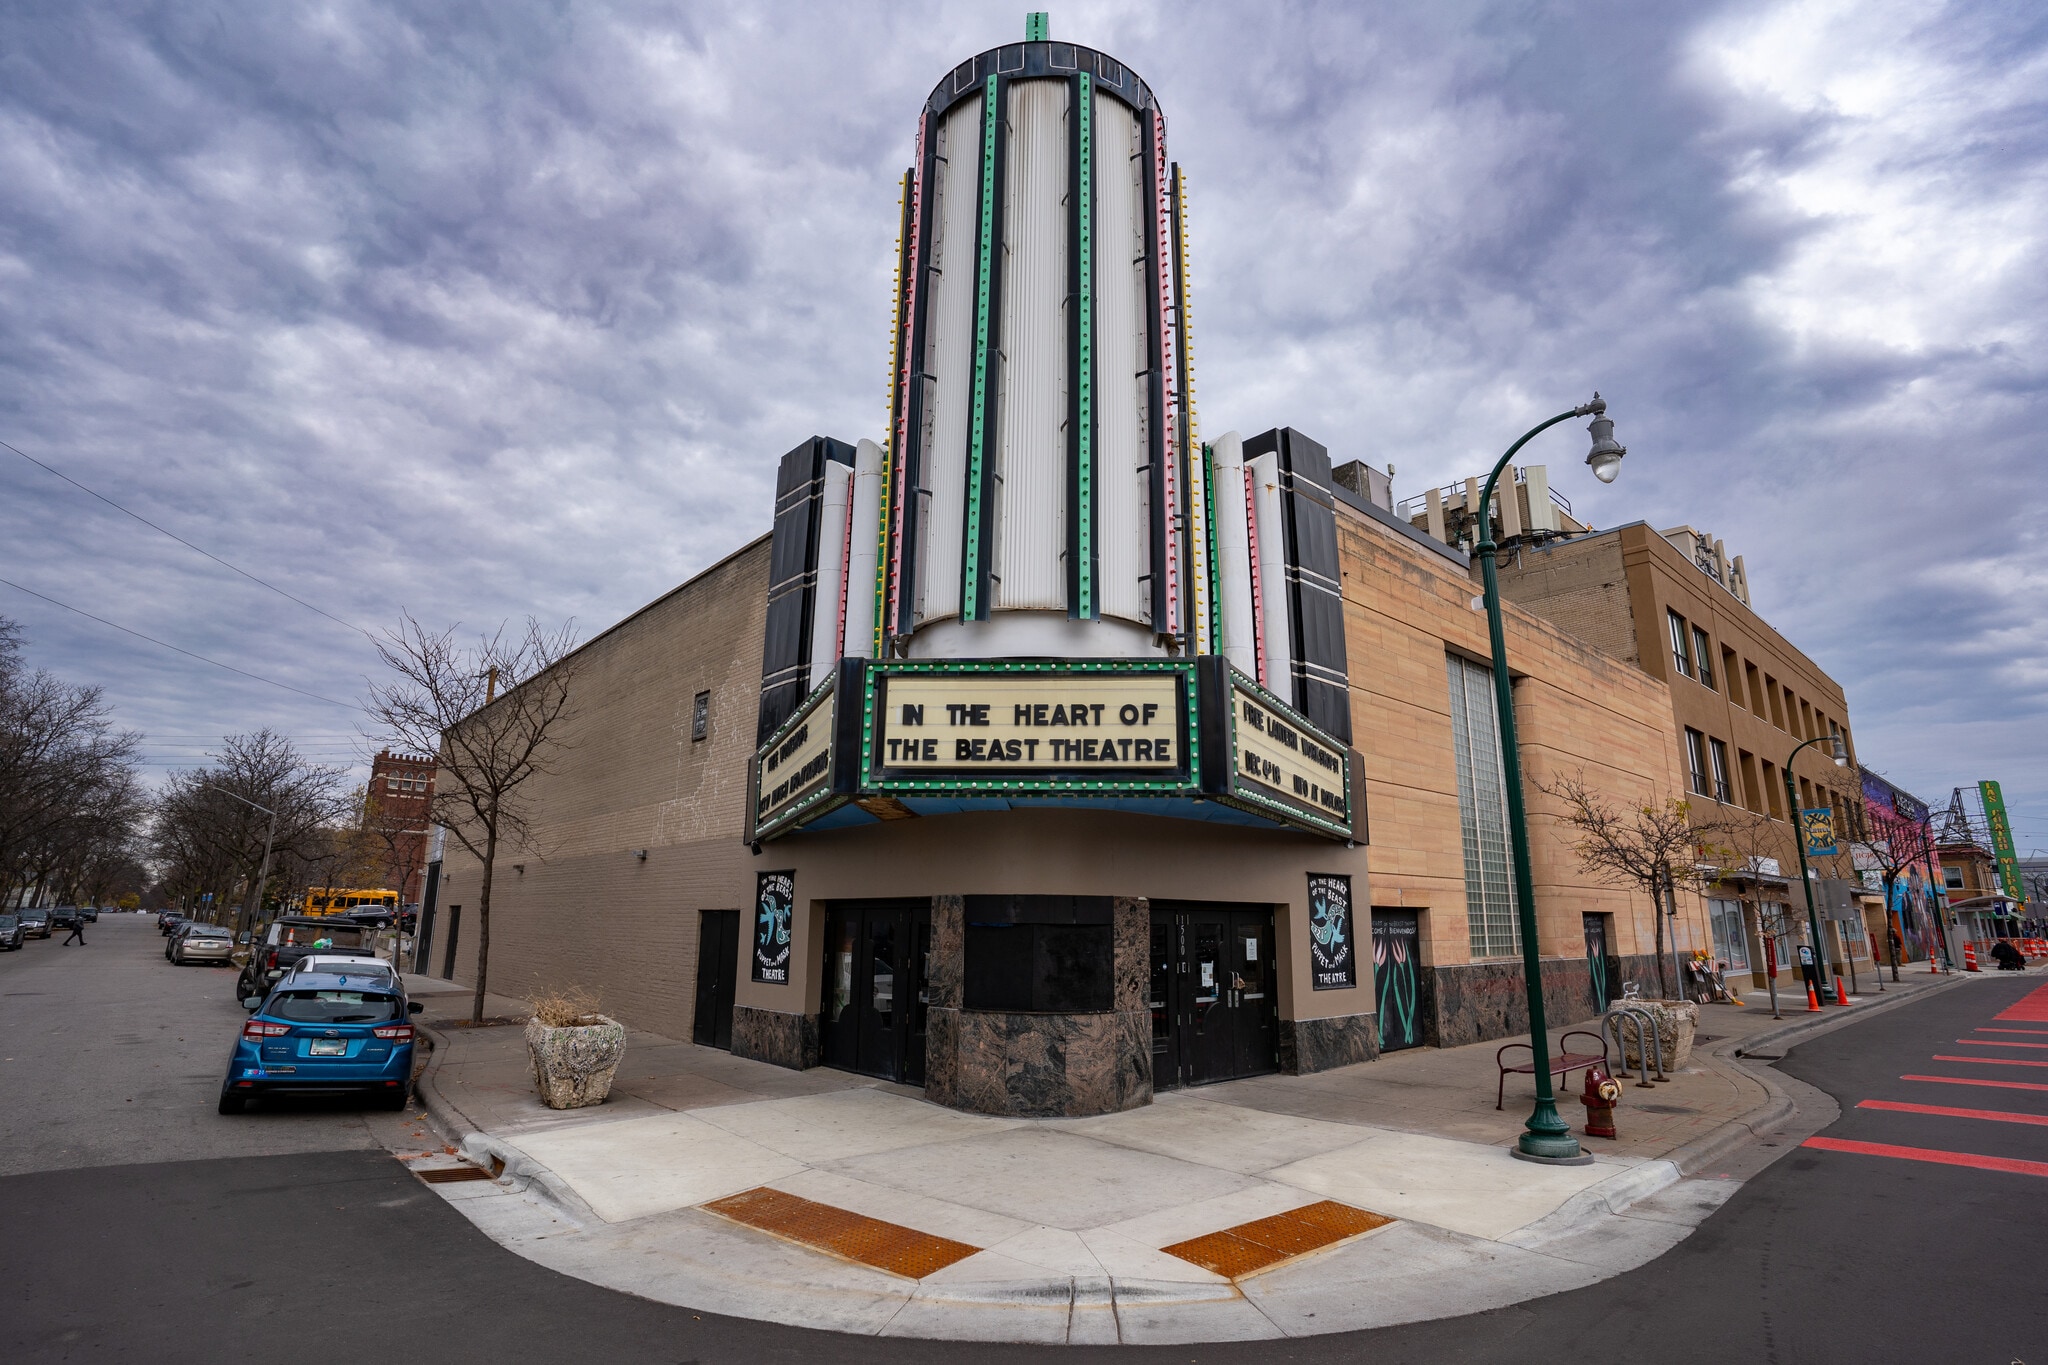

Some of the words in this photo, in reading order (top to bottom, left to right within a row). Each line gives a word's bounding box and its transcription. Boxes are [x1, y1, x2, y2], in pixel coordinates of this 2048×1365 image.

[946, 703, 991, 726] THE
[1014, 703, 1105, 726] HEART
[1119, 703, 1158, 726] OF
[887, 738, 938, 761] THE
[955, 738, 1040, 761] BEAST
[1049, 738, 1171, 761] THEATRE
[775, 882, 793, 901] BEAST
[776, 874, 793, 891] HEART
[1327, 877, 1348, 895] HEART
[1312, 888, 1317, 896] OF
[1327, 888, 1348, 908] BEAST
[756, 948, 772, 967] PUPPET
[776, 945, 790, 965] MASK
[1311, 942, 1329, 969] PUPPET
[1333, 944, 1349, 966] MASK
[761, 967, 785, 980] THEATRE
[1318, 971, 1347, 984] THEATRE
